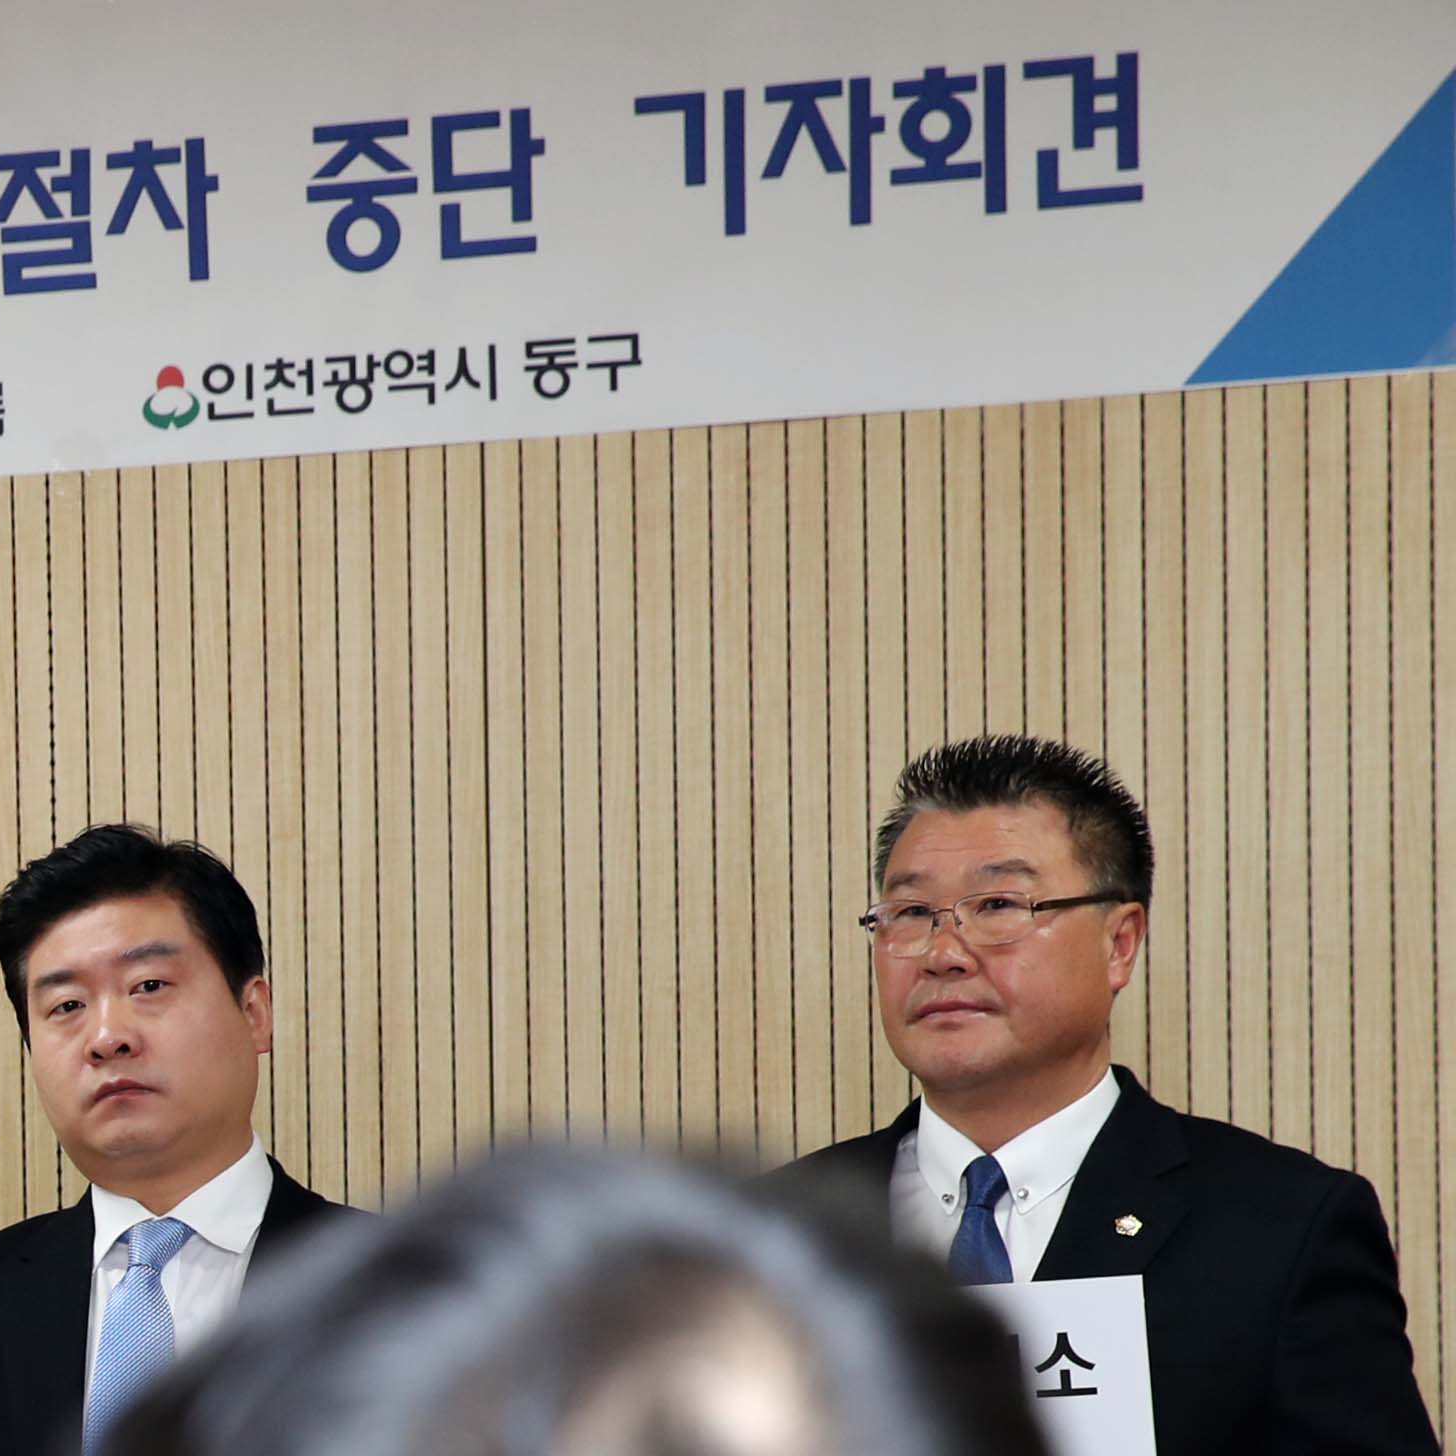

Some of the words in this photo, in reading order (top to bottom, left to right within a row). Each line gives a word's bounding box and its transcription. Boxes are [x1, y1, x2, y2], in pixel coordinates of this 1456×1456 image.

[305, 107, 547, 273] 중단
[633, 51, 1145, 237] 기자회견
[200, 343, 499, 423] 인천광역시
[522, 331, 644, 401] 동구
[1009, 1331, 1099, 1399] 소
